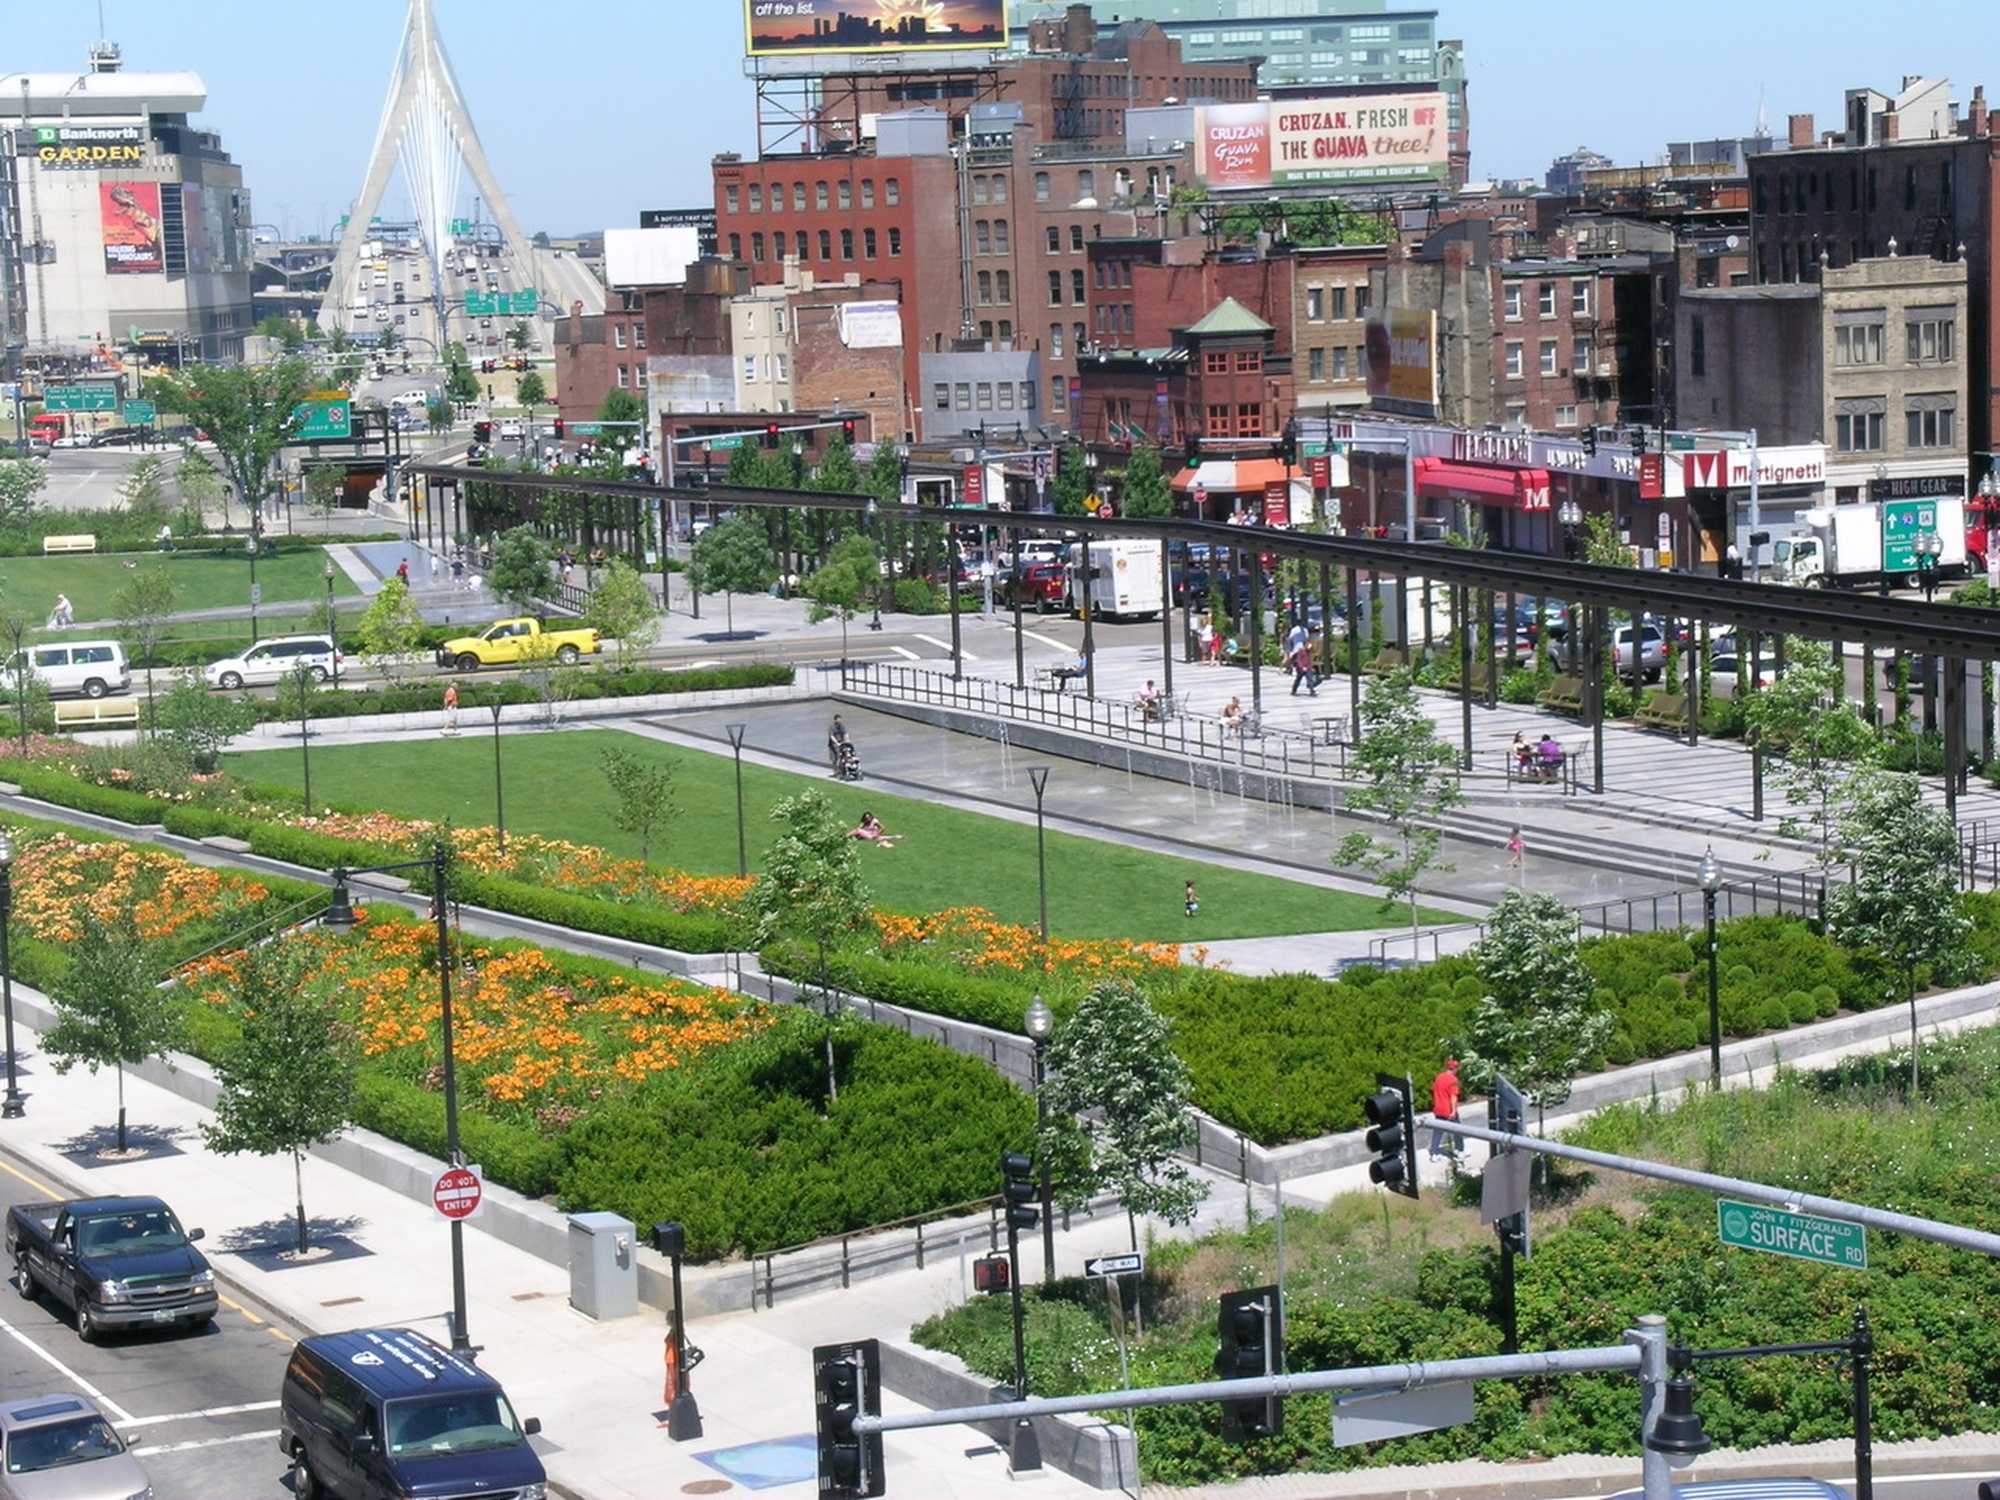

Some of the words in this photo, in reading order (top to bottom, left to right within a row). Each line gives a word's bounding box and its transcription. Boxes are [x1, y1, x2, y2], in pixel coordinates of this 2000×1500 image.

[755, 3, 773, 16] off
[774, 3, 794, 16] the
[1356, 107, 1408, 129] FRESH
[1413, 107, 1437, 126] OFF
[39, 129, 55, 140] TD
[59, 127, 138, 140] Banknorth
[1210, 126, 1264, 140] CRUZAN
[39, 146, 140, 161] GARDEN
[1280, 140, 1308, 160] THE
[1313, 135, 1369, 159] GUAVA
[1891, 480, 1919, 496] HIGH
[1920, 479, 1949, 493] GEAR
[1524, 487, 1550, 509] M
[1750, 1210, 1777, 1224] JOHN
[1779, 1216, 1786, 1225] F
[1790, 1218, 1852, 1237] FITZGERALD
[1750, 1222, 1837, 1258] SURFACE
[1845, 1248, 1863, 1262] RD
